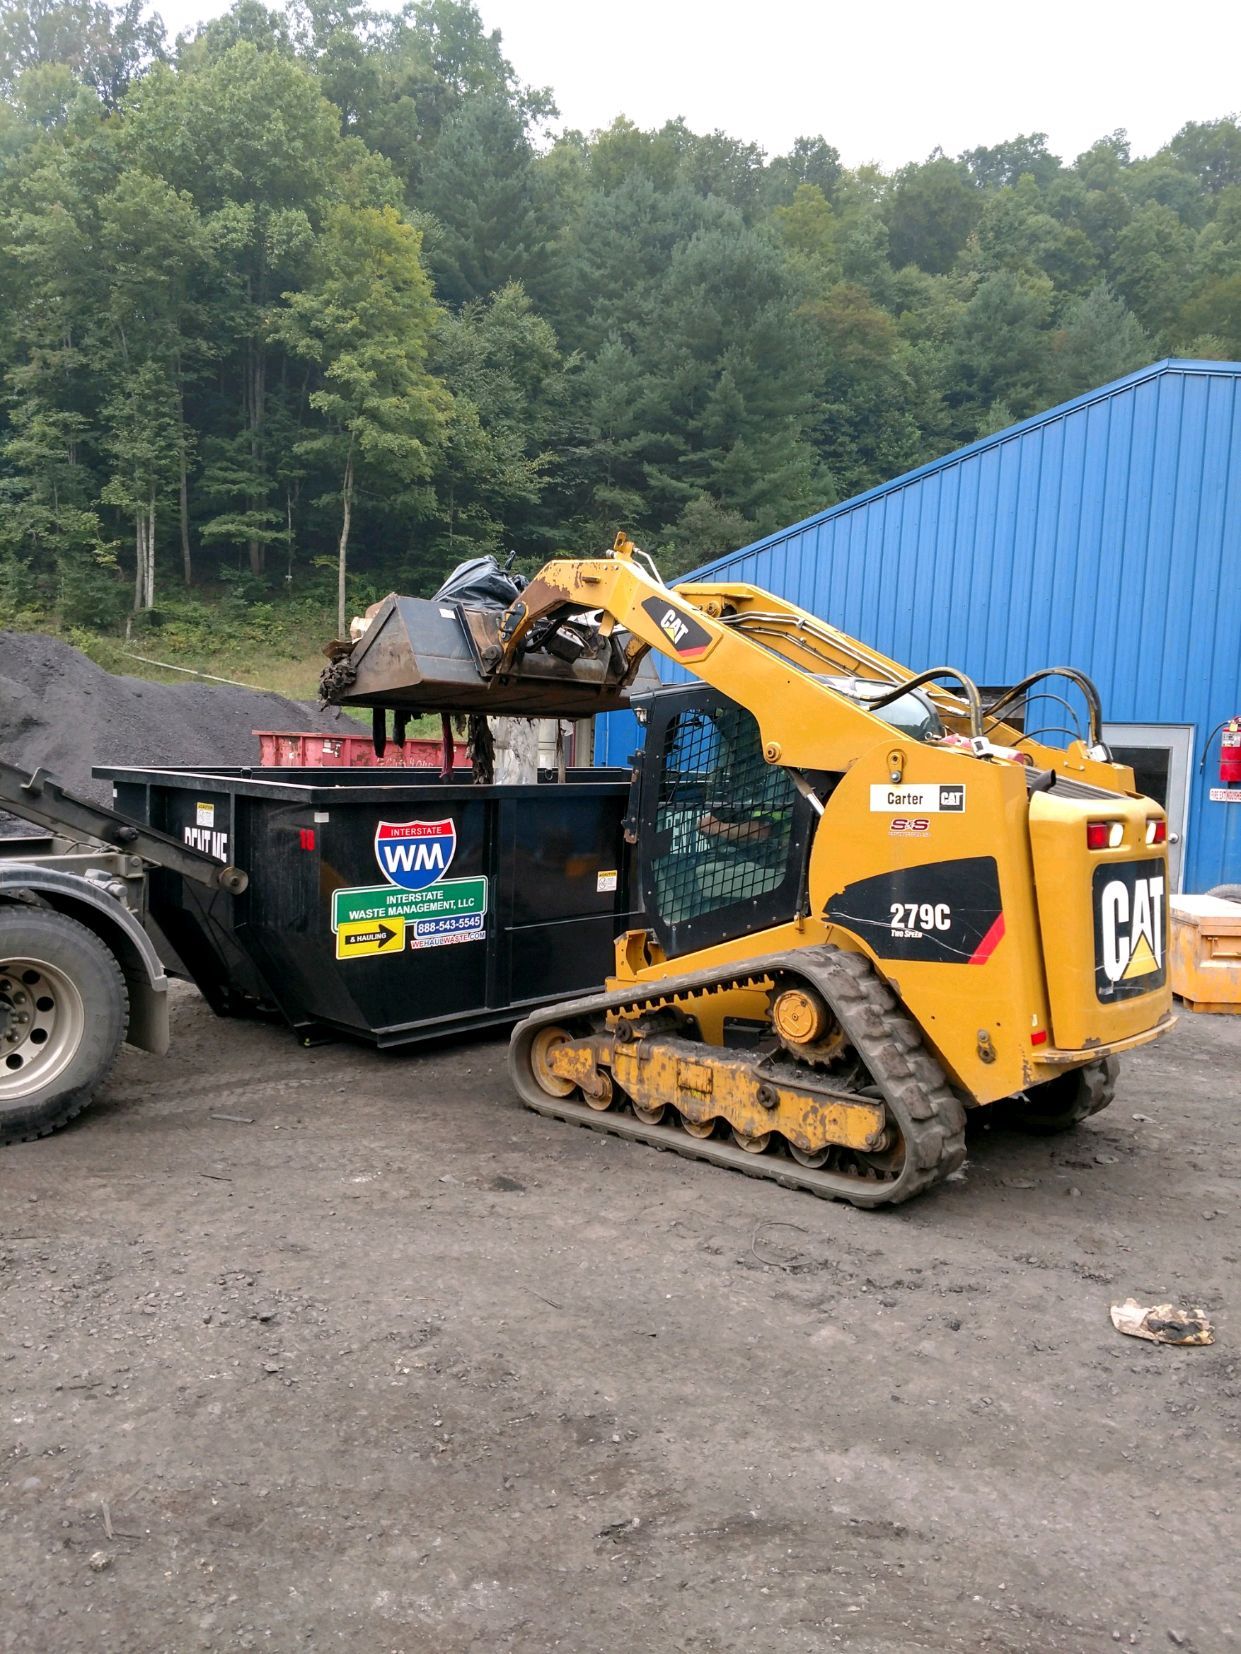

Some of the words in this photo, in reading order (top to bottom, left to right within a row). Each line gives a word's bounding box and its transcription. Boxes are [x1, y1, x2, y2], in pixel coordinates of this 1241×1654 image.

[660, 609, 689, 645] CAT
[887, 792, 924, 805] Carter
[940, 792, 964, 806] CAT
[391, 827, 442, 837] INTERSTATE
[384, 843, 445, 873] WM
[386, 891, 444, 905] INTERSTATE
[349, 909, 386, 920] WASTE
[388, 901, 456, 915] MANAGEMENT,
[458, 898, 475, 907] LLC
[890, 903, 951, 931] 279C
[418, 917, 481, 934] 888-543-5545
[1101, 876, 1164, 982] CAT
[357, 933, 387, 943] HAULING
[411, 932, 486, 949] WEHAULWASTE.COM
